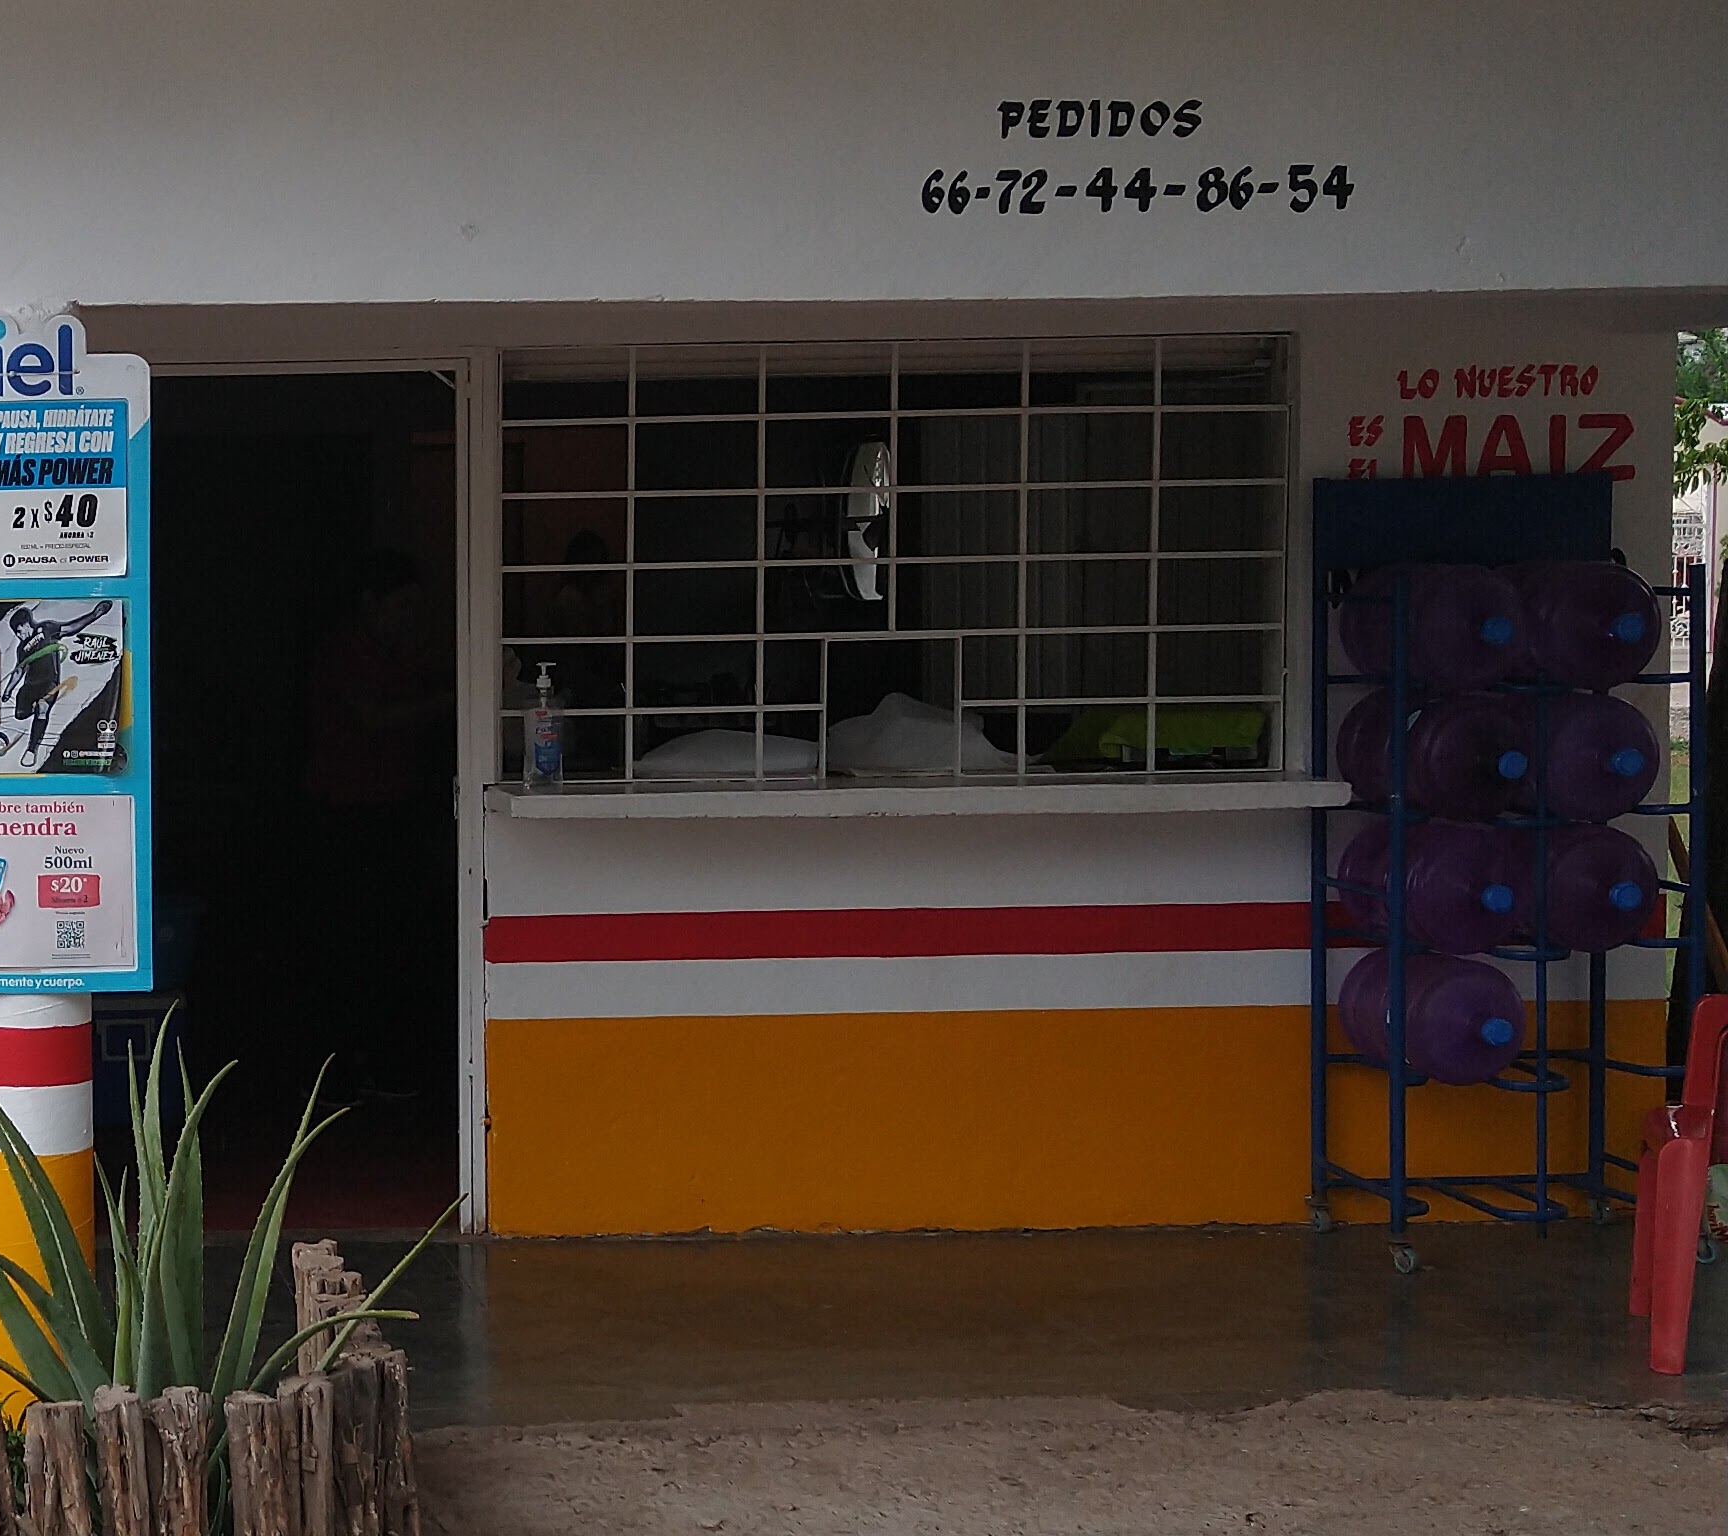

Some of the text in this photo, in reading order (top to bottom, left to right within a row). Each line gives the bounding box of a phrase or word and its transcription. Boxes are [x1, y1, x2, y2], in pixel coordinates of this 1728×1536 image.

[997, 99, 1203, 139] PEDIDOS
[921, 164, 1355, 215] 66-72-44-86-54
[1397, 363, 1599, 399] LO NUESTRO
[43, 404, 115, 427] HIDRÁTATE
[4, 431, 76, 454] REGRESA
[79, 430, 115, 453] CON
[1347, 414, 1385, 446] ES
[1401, 413, 1636, 482] MAIZ
[38, 457, 115, 486] POWER
[12, 506, 26, 529] 2
[43, 493, 99, 528] $40
[17, 556, 58, 564] PAUSA
[69, 555, 110, 563] POWER
[25, 800, 85, 813] también
[44, 855, 93, 869] 500ml
[54, 845, 85, 854] Nuevo
[34, 978, 43, 989] y
